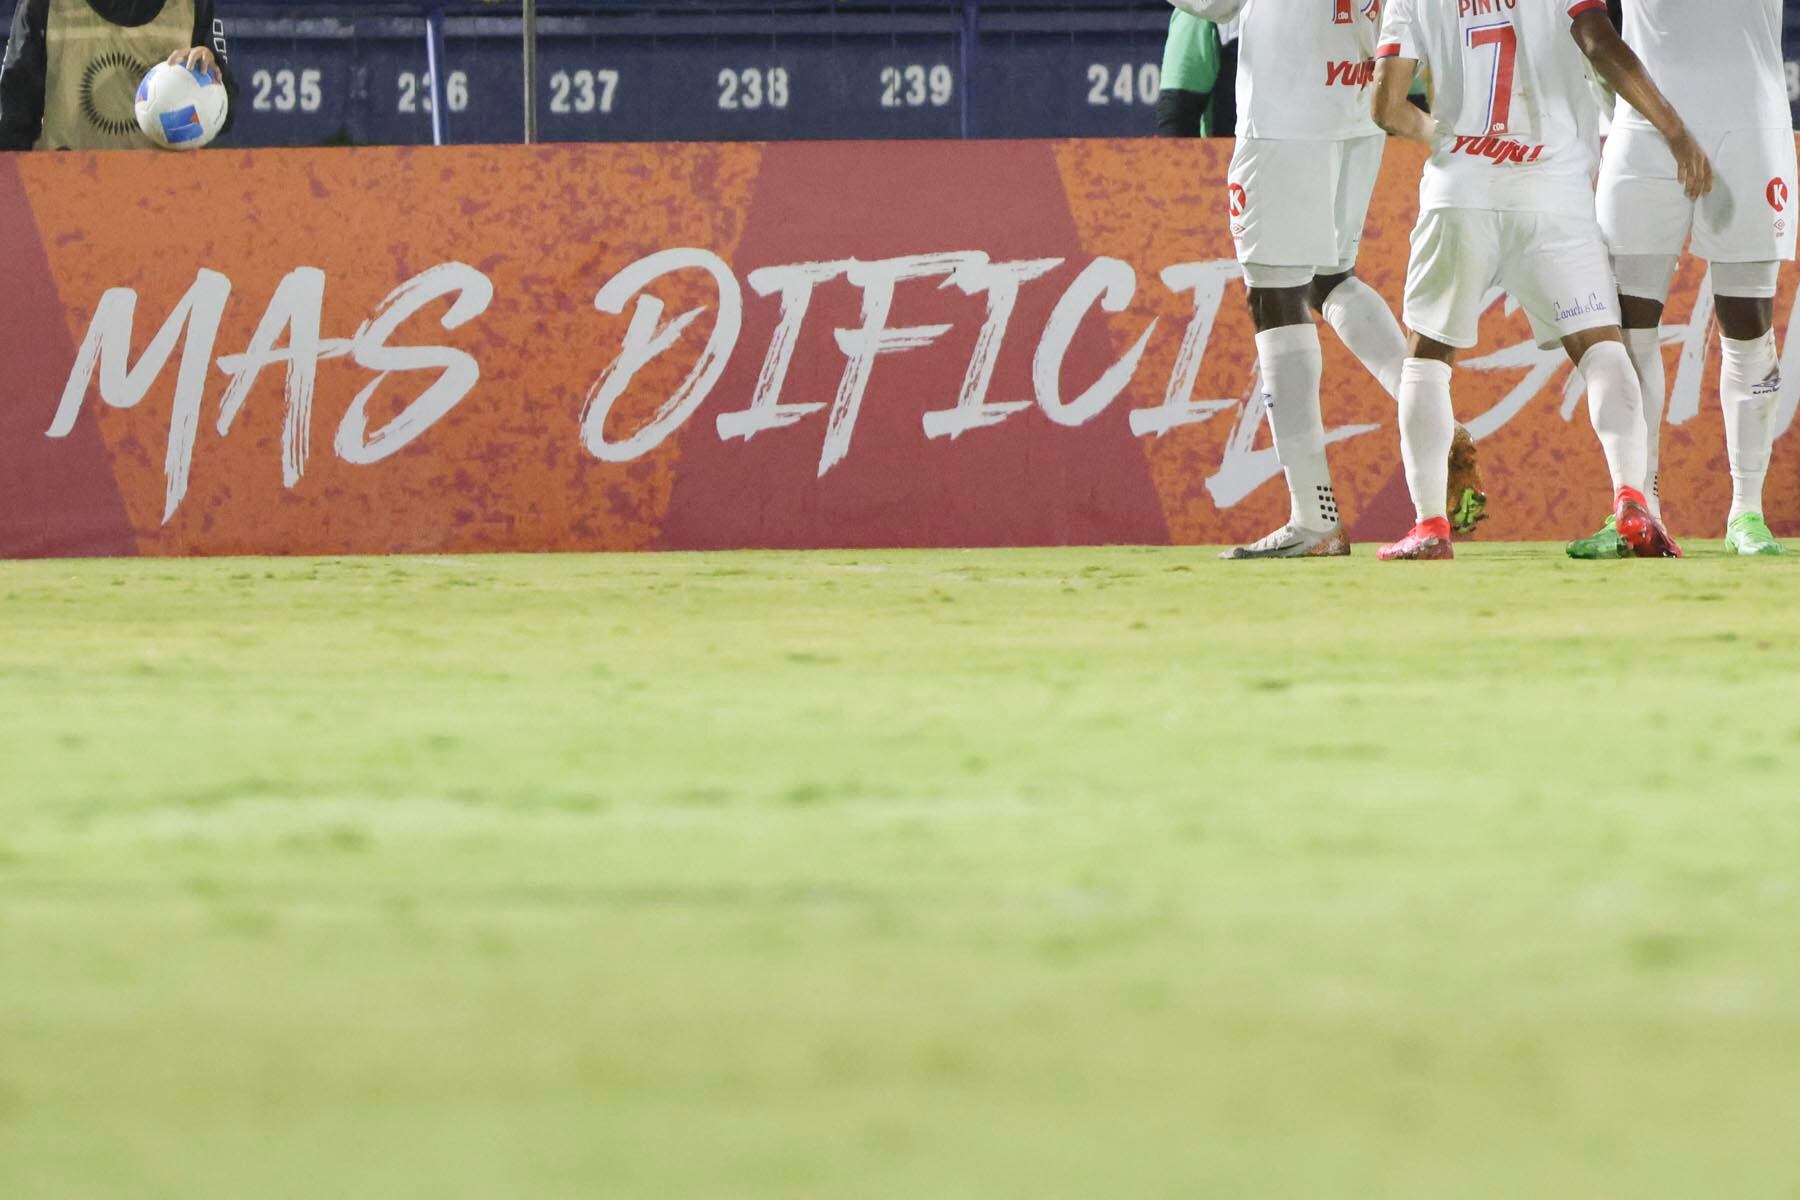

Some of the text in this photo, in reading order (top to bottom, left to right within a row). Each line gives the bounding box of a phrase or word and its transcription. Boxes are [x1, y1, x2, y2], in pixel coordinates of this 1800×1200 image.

[251, 69, 322, 111] 235
[549, 69, 620, 113] 237
[717, 67, 790, 109] 238
[880, 64, 954, 107] 239
[1087, 64, 1162, 107] 240
[1465, 21, 1517, 137] 7
[45, 260, 493, 526] MAS
